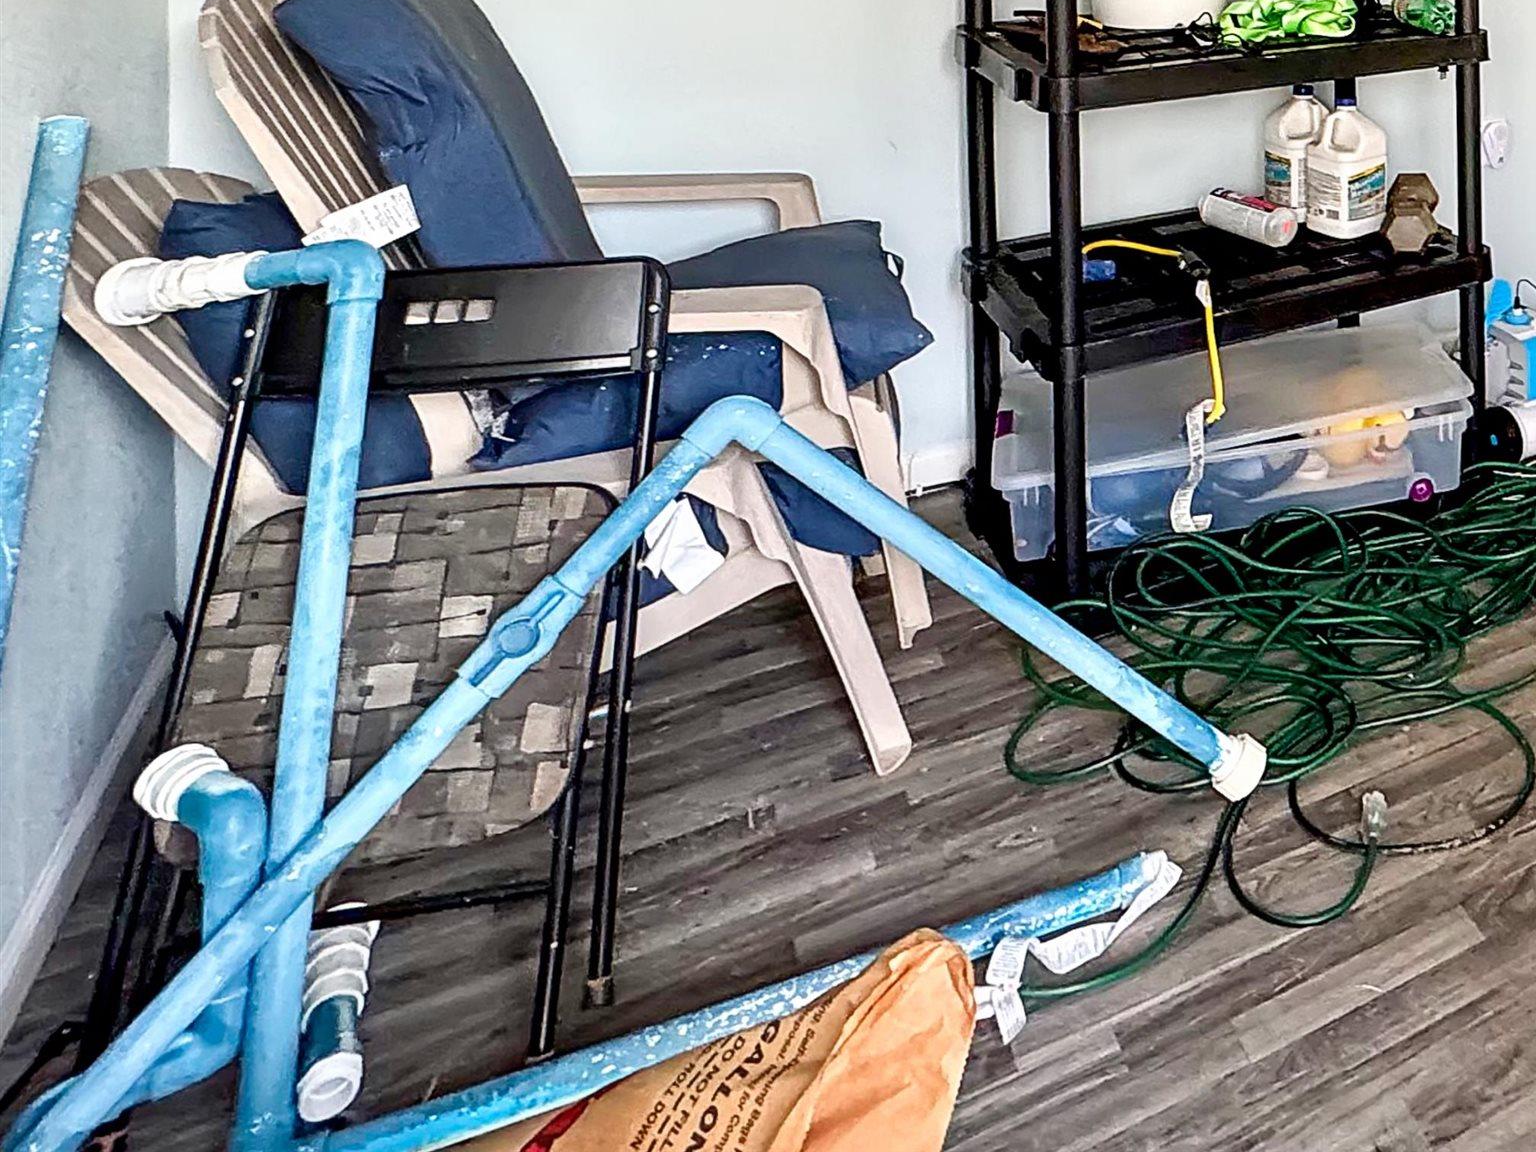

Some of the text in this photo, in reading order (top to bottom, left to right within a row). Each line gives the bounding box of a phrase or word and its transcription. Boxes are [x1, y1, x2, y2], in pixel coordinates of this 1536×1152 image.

[721, 1035, 746, 1063] DO
[629, 1062, 696, 1151] ROLL DOWN
[689, 1065, 720, 1108] NOT
[737, 1091, 750, 1112] for
[659, 1109, 690, 1152] FILL
